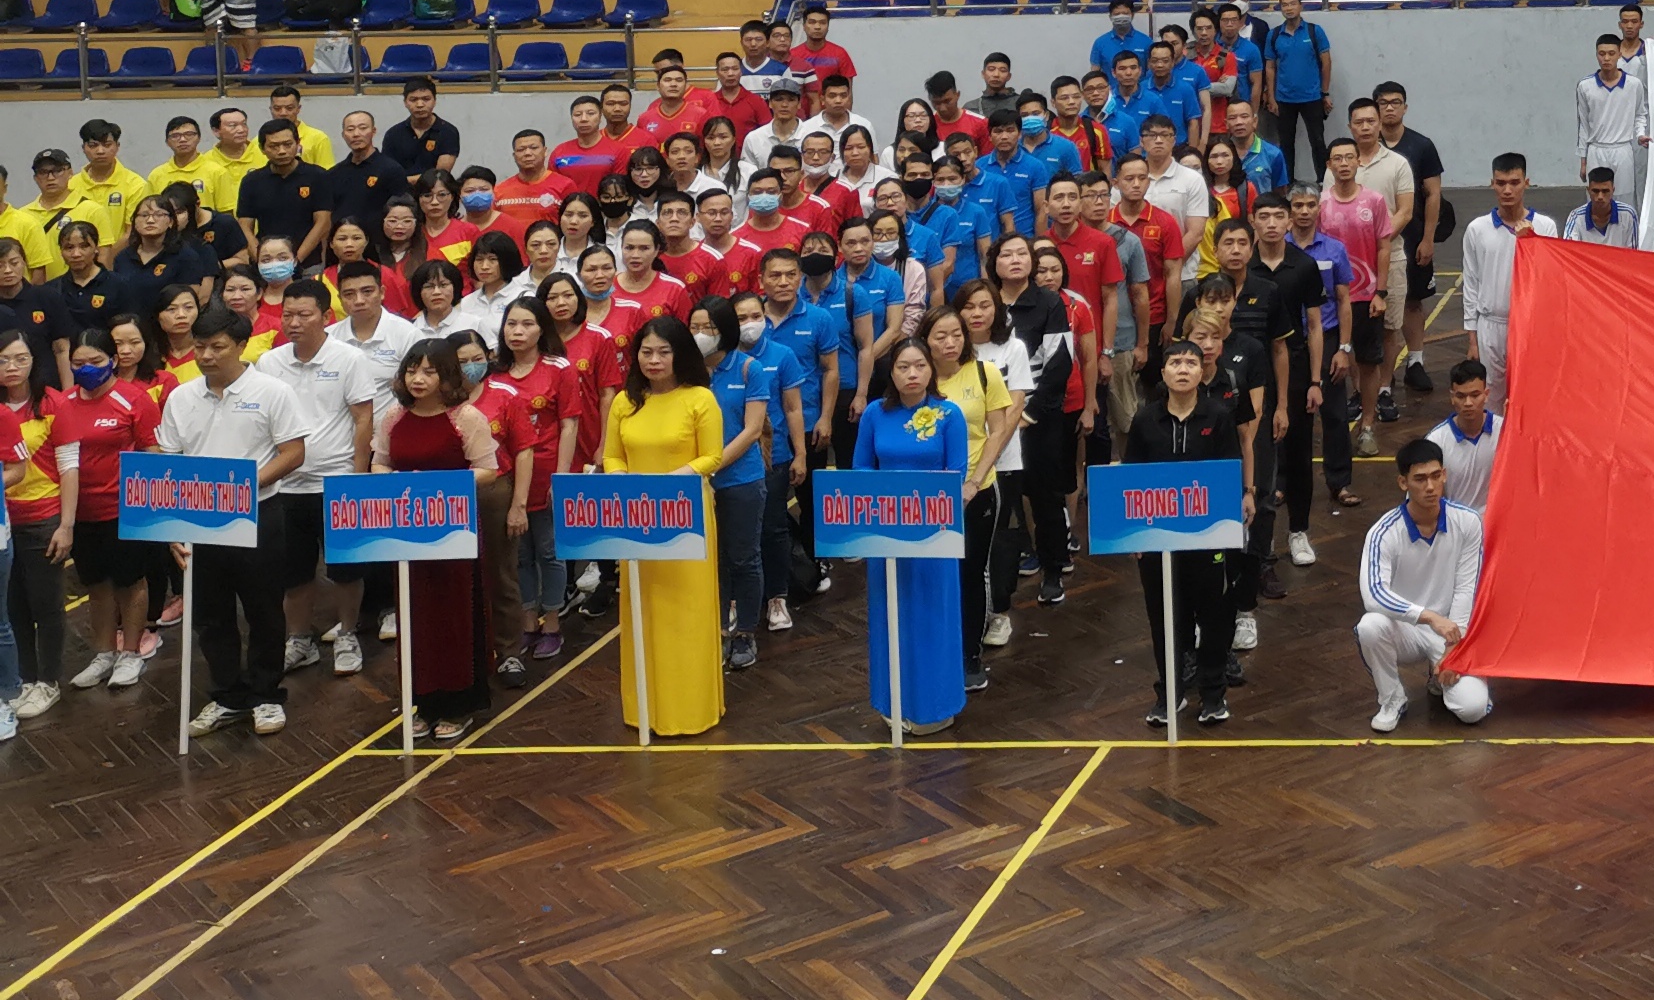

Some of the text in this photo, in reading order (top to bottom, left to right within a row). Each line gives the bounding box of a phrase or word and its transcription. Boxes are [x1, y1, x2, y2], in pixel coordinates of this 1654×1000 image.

[125, 469, 252, 514] BÁO QUỐC PHÒNG THỦ ĐÔ
[330, 486, 470, 532] BÁO KINH TẾ & ĐÔ THỊ
[563, 491, 693, 534] BÁO HÀ NỘI MỚI
[823, 489, 954, 531] ĐÀI PT-TH HÀ NỘI
[1123, 480, 1209, 525] TRỌNG TÀI
